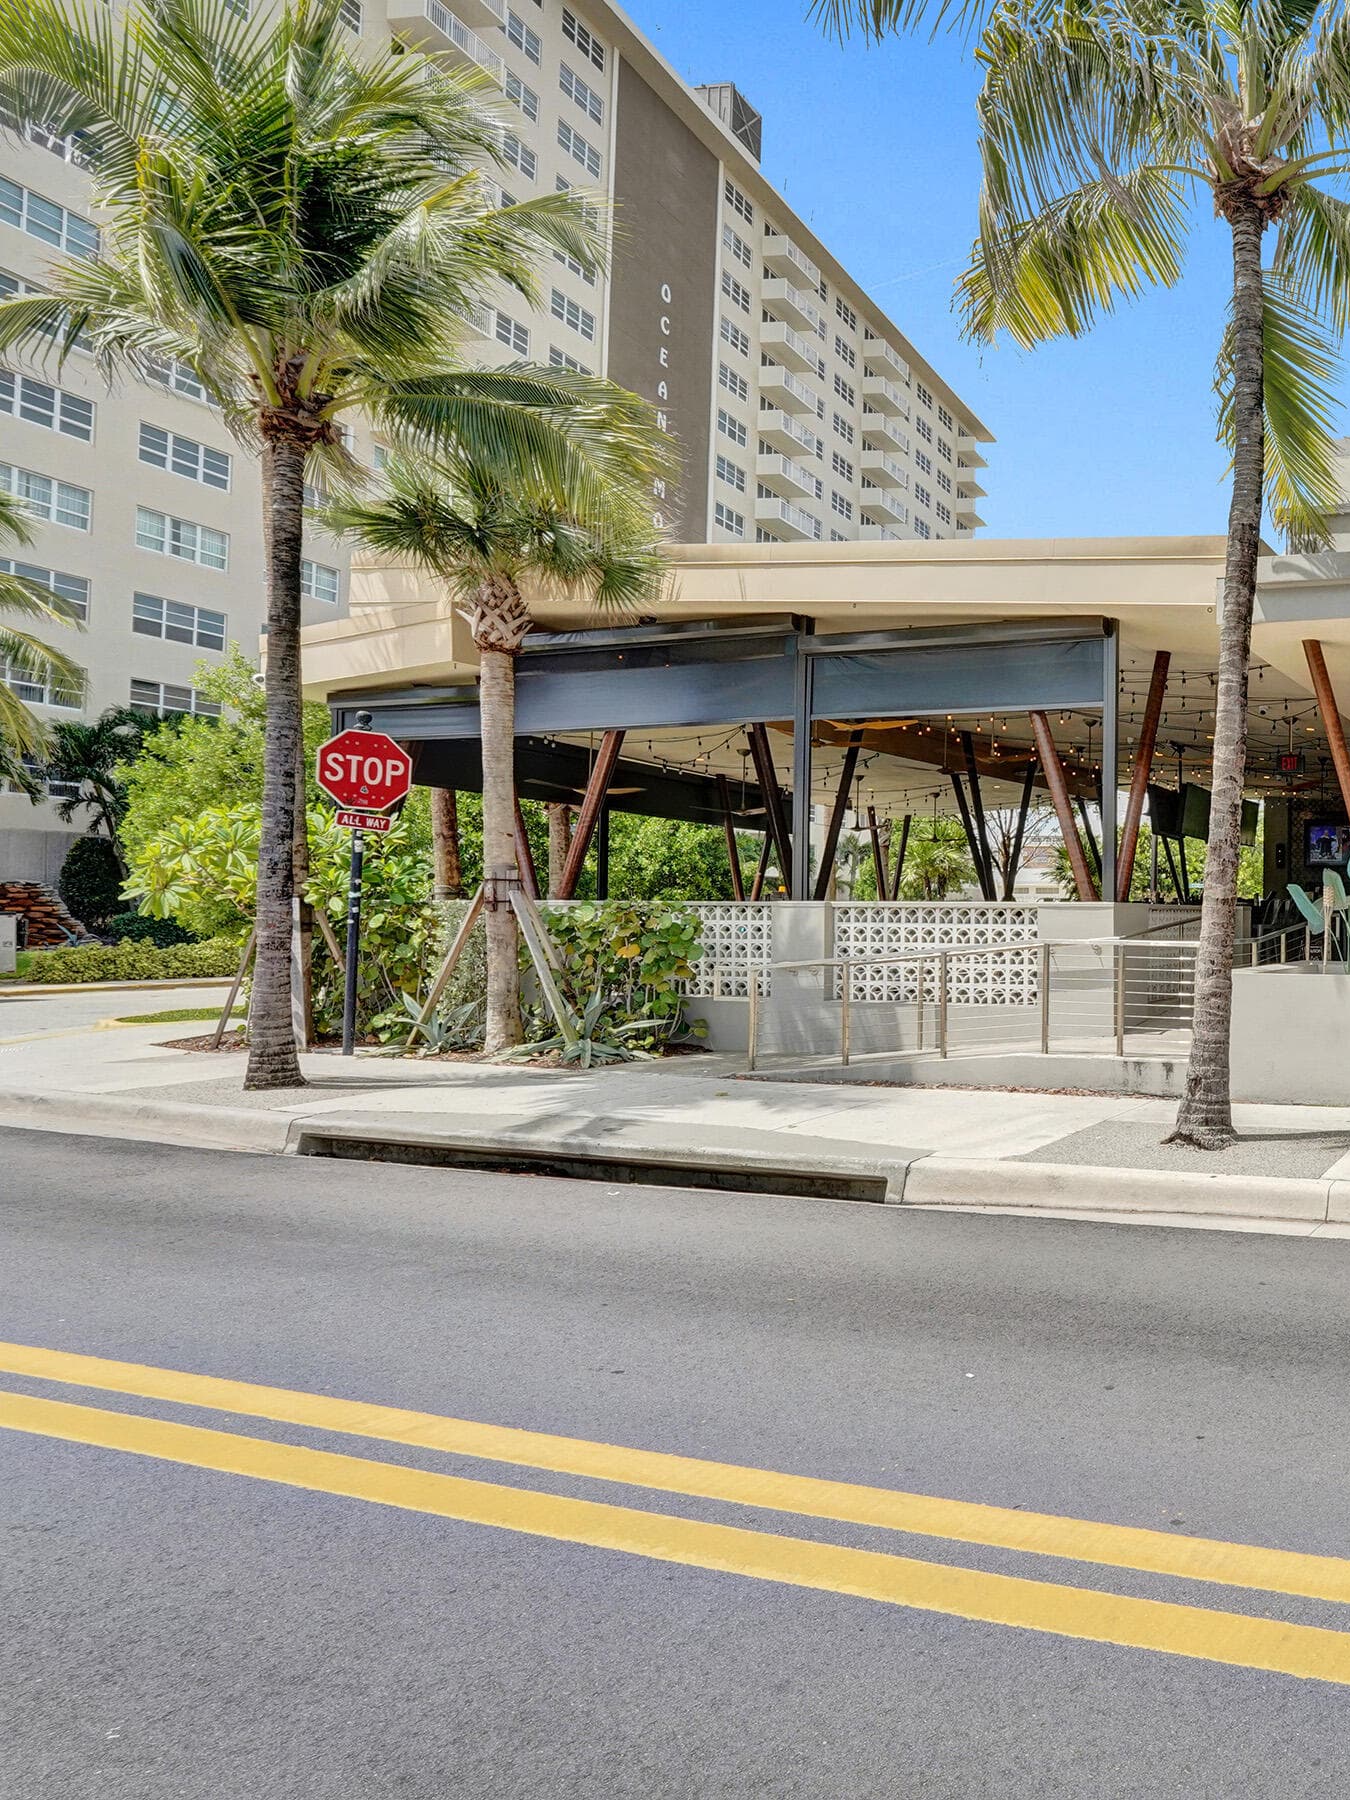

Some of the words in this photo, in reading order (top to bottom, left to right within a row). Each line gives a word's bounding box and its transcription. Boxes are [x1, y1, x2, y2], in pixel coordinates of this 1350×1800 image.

[656, 284, 671, 432] OCEAN
[324, 752, 405, 787] STOP
[1281, 757, 1297, 770] EXIT
[341, 815, 362, 826] ALL
[366, 818, 387, 829] WAY
